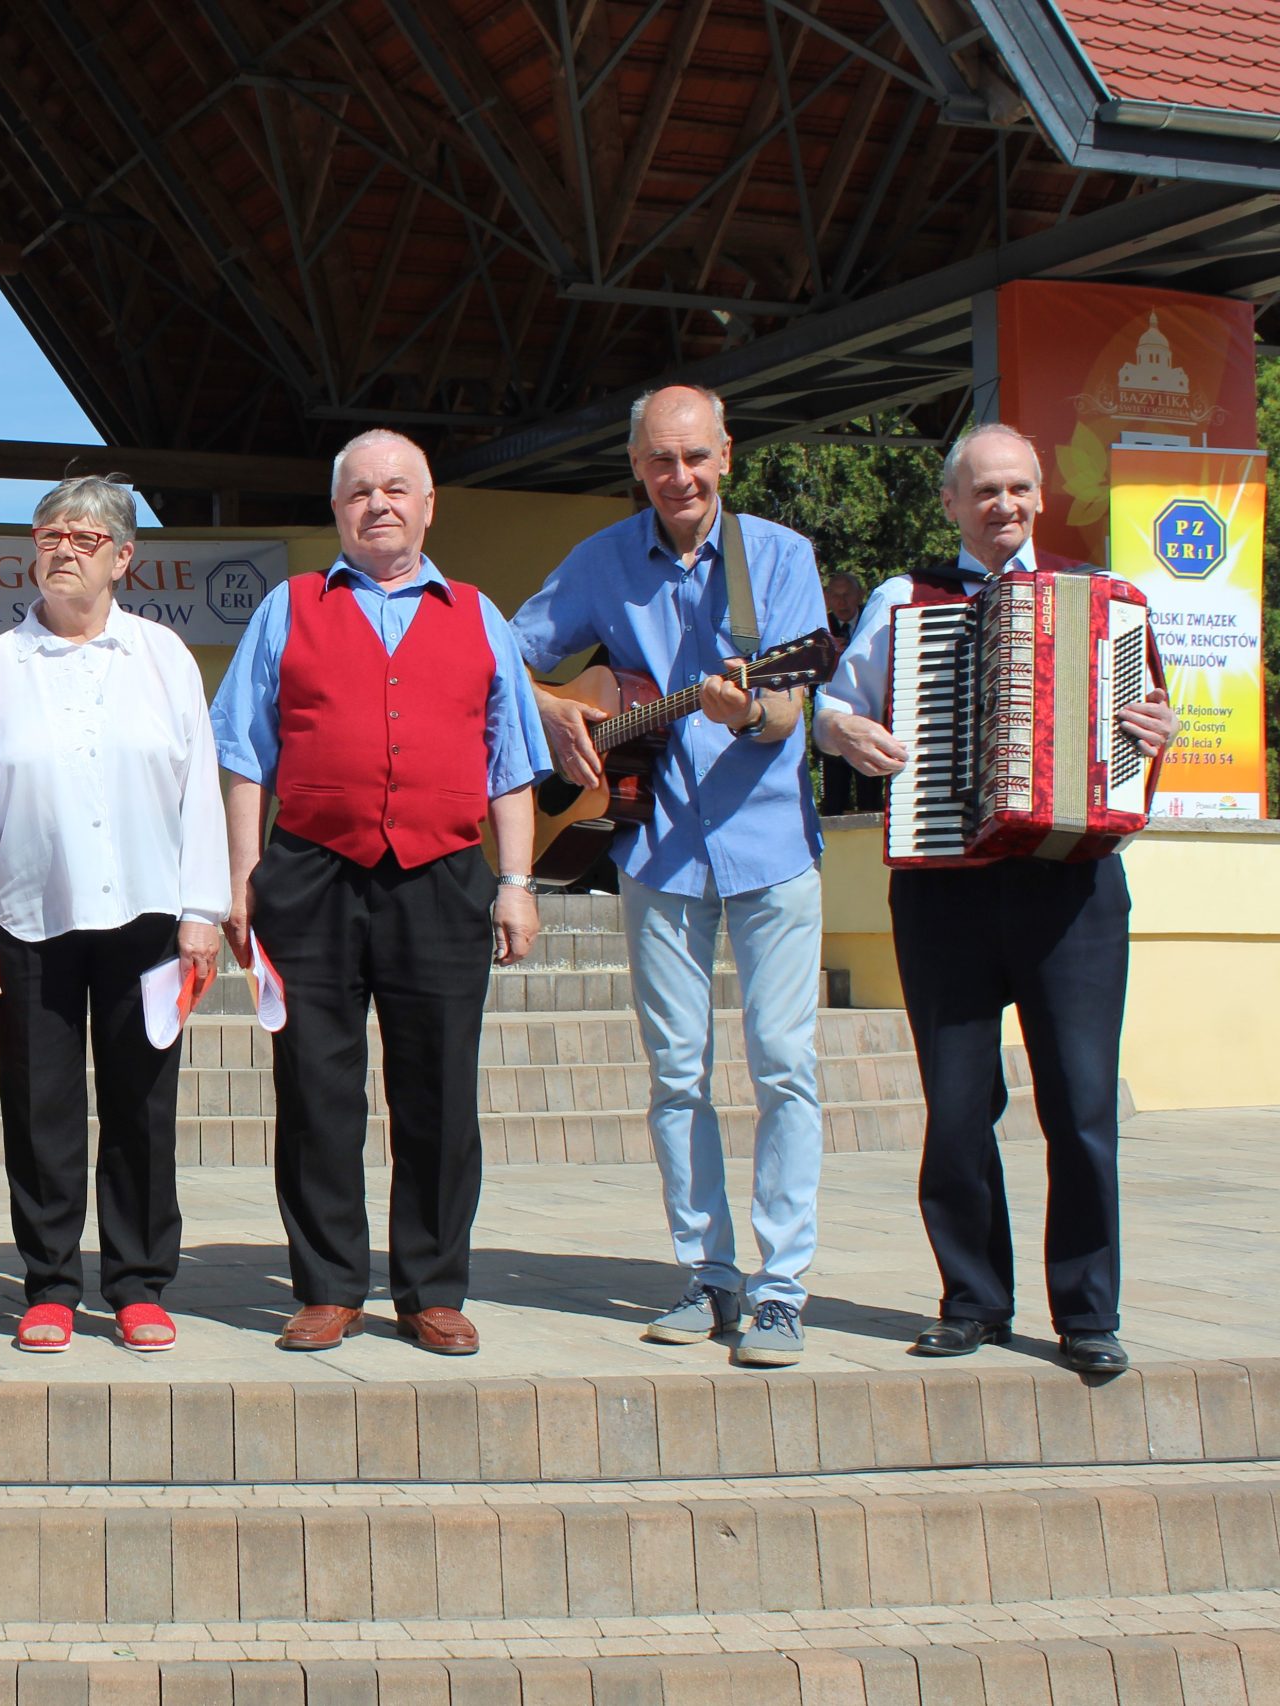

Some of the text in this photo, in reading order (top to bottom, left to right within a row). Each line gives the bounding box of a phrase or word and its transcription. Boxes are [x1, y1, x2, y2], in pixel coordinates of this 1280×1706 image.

[1120, 391, 1189, 409] BAZYLIKA
[1175, 519, 1205, 537] PZ
[225, 573, 249, 590] PZ
[220, 593, 253, 609] ERI
[1150, 612, 1183, 626] OLSKI
[1191, 633, 1258, 648] RENCISTÓW
[1187, 704, 1233, 717] Rejonowy
[1165, 752, 1178, 764] 65
[1203, 754, 1216, 765] 30
[1219, 754, 1234, 765] 54
